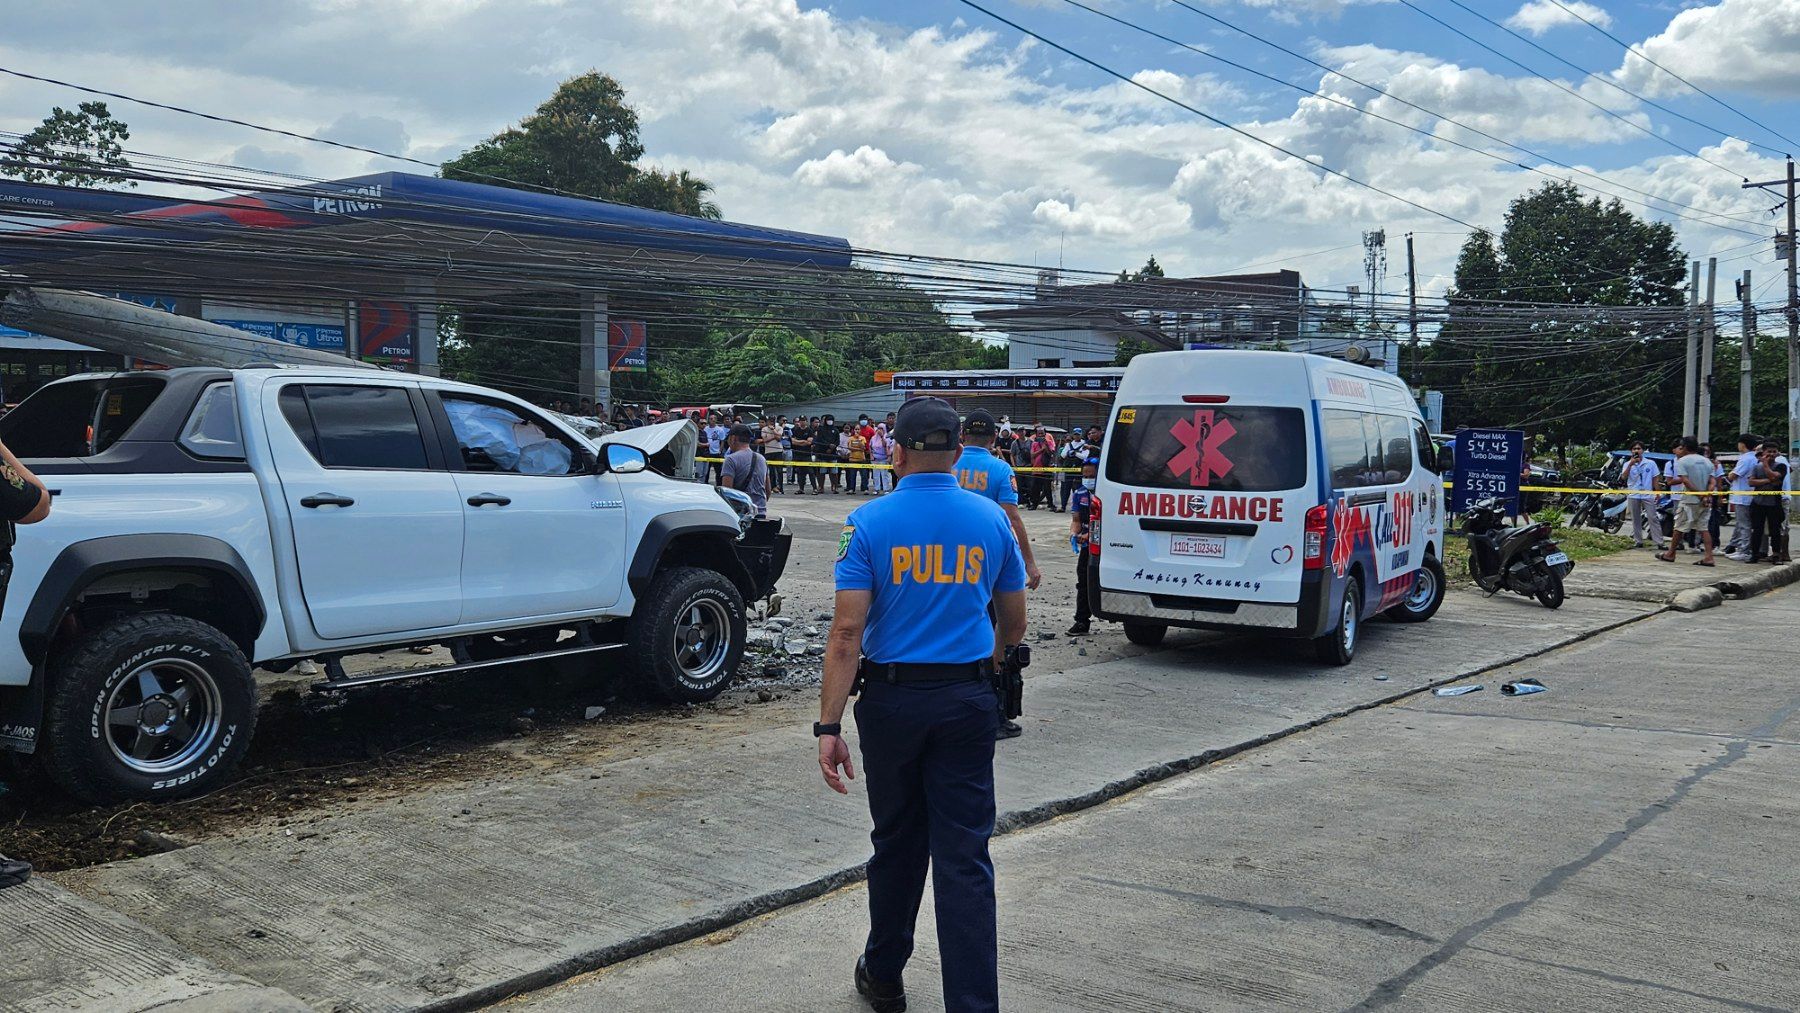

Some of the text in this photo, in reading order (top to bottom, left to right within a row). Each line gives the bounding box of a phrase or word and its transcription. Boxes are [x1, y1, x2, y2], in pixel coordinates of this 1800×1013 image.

[0, 194, 54, 206] CARE CENTER
[382, 346, 411, 355] PETRON
[1472, 432, 1491, 440] Diesel
[1467, 439, 1509, 453] 54.45
[1471, 452, 1507, 461] Turbo Diesel
[1468, 471, 1506, 480] Xtra Advance
[1466, 479, 1506, 493] 55.50
[1479, 491, 1492, 499] XCS
[1118, 491, 1284, 523] AMBULANCE
[891, 544, 984, 585] PULIS
[1133, 569, 1262, 592] Amping Kanunay
[692, 588, 730, 600] COUNTRY
[678, 670, 728, 690] TOYO TIRES
[91, 644, 211, 739] OPEN COUNTRY R/T
[10, 725, 36, 738] JAOS
[151, 724, 237, 790] TOYO TIRES
